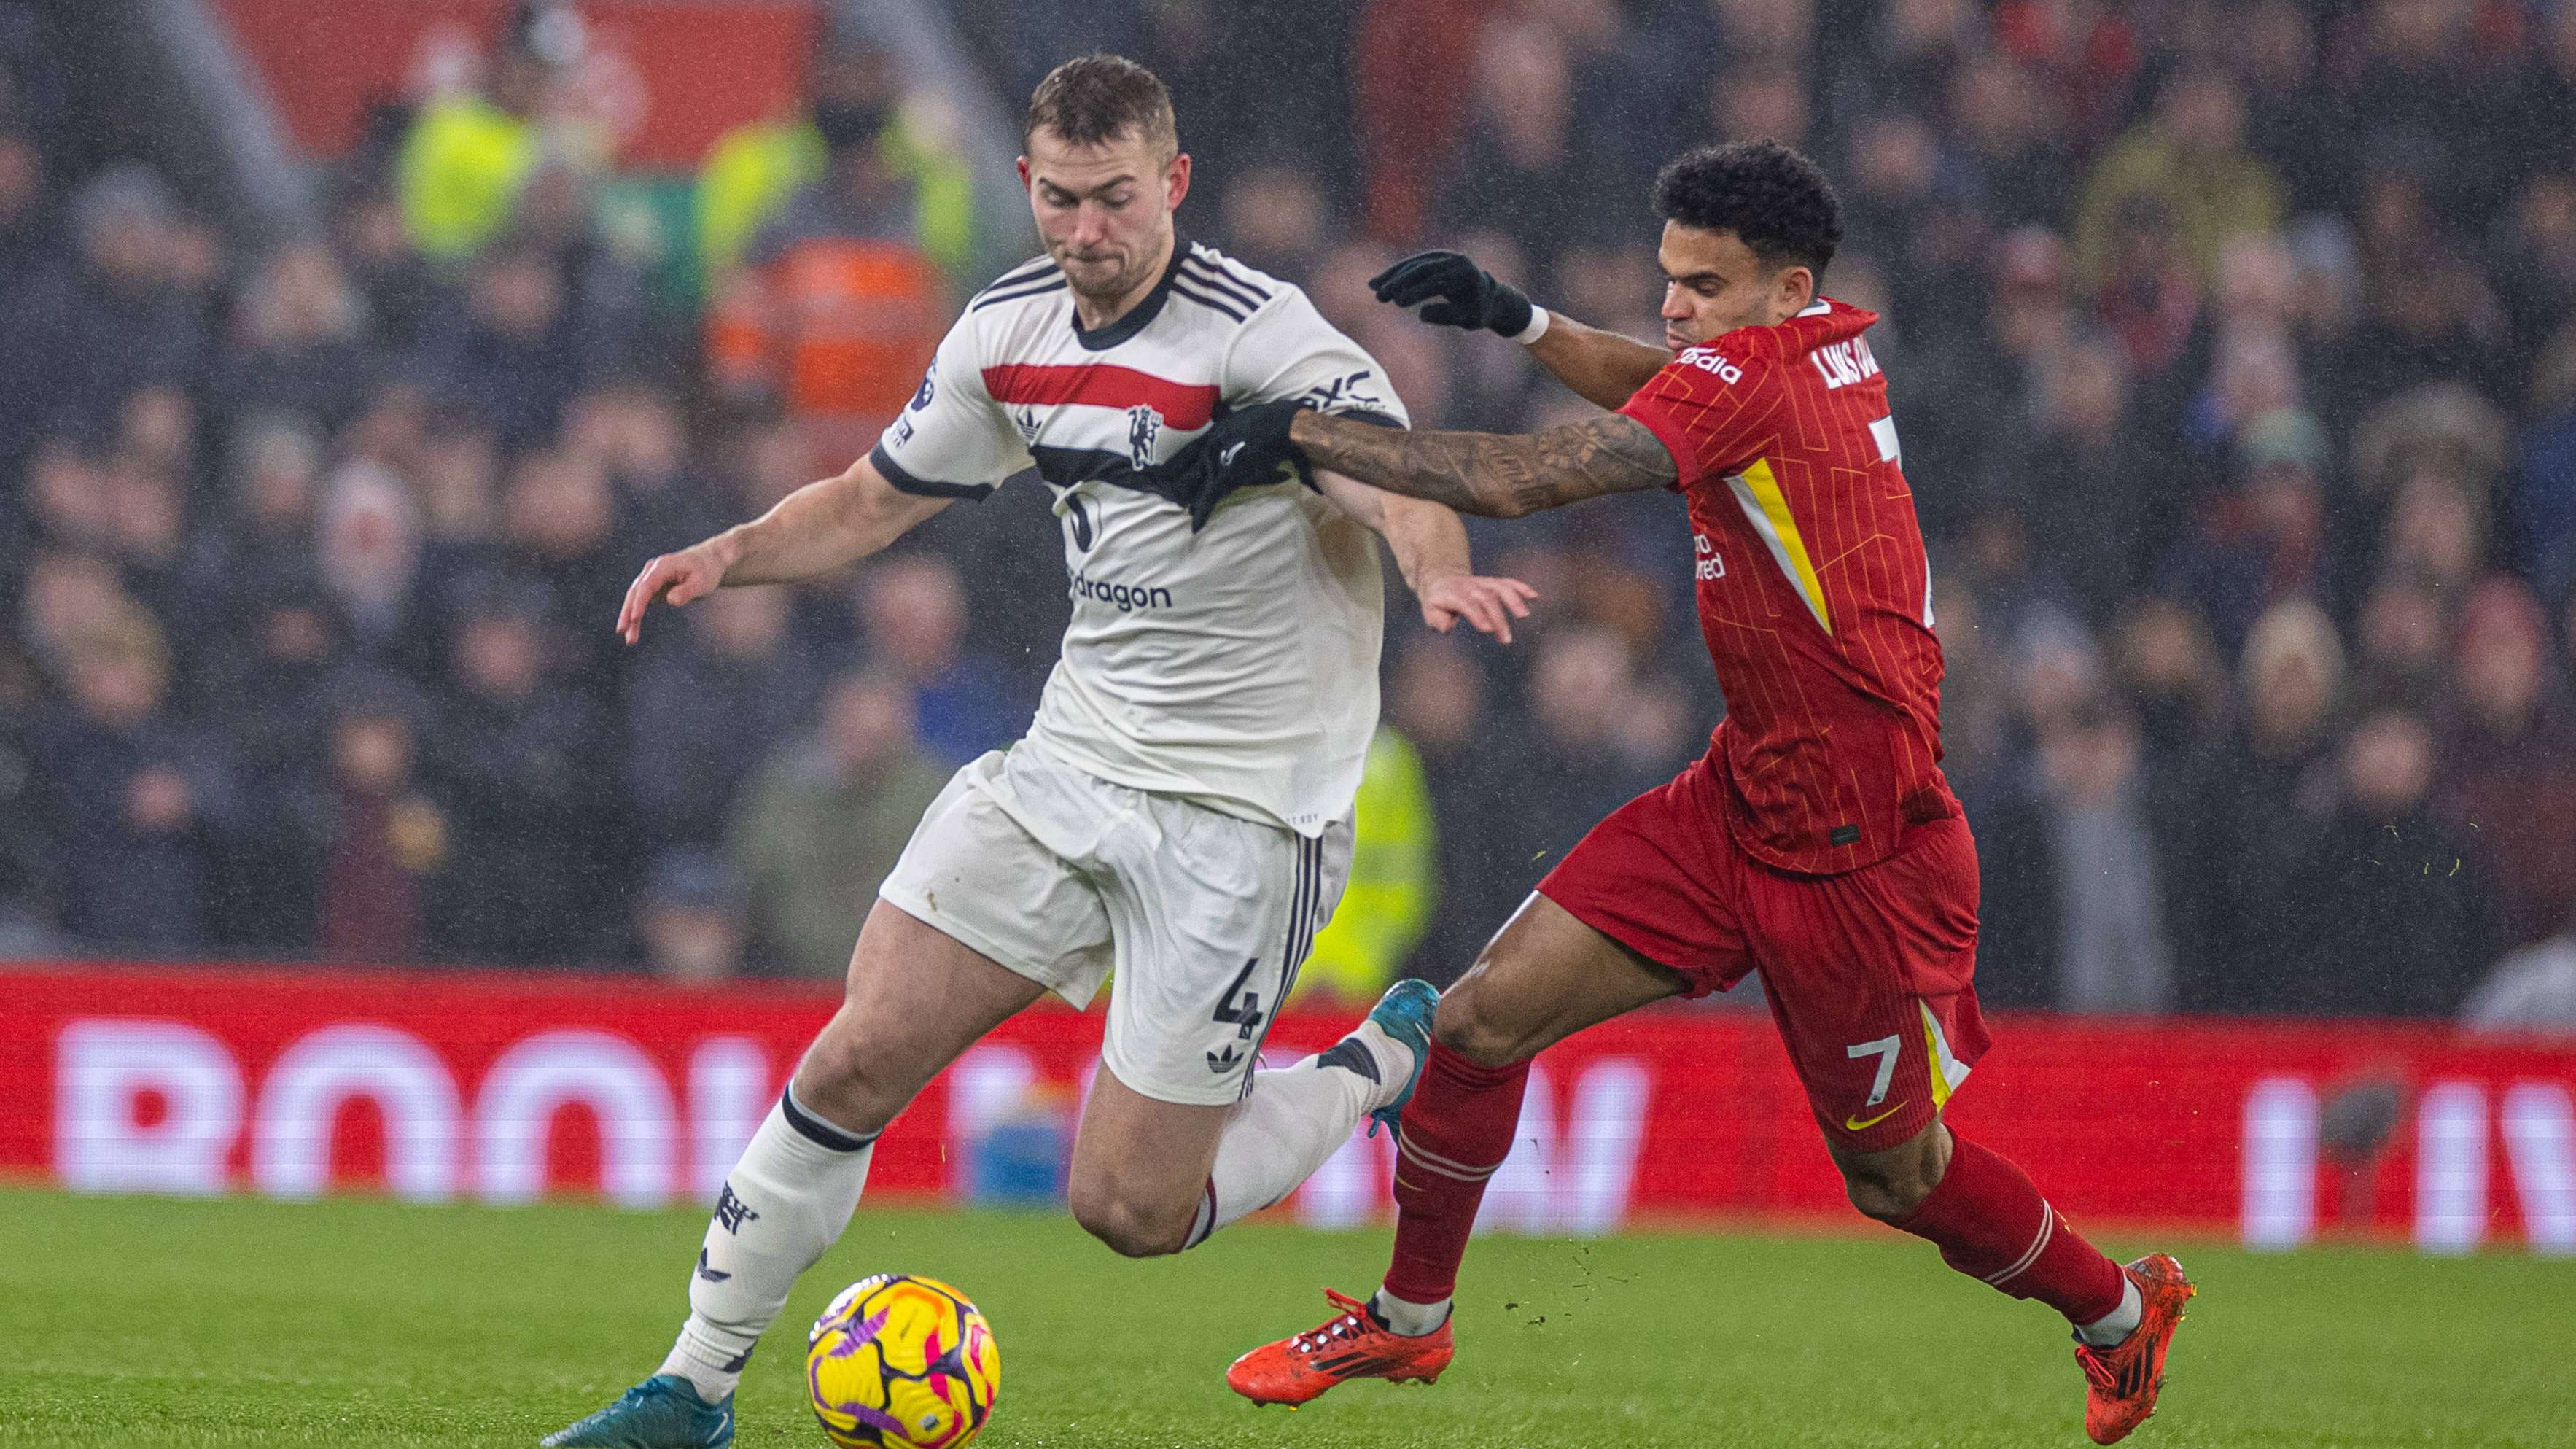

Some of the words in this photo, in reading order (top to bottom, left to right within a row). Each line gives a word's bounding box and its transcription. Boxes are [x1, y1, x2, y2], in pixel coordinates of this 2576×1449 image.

[1073, 570, 1173, 612] dragon
[1212, 957, 1264, 1039] 4
[1846, 1033, 1902, 1107] 7
